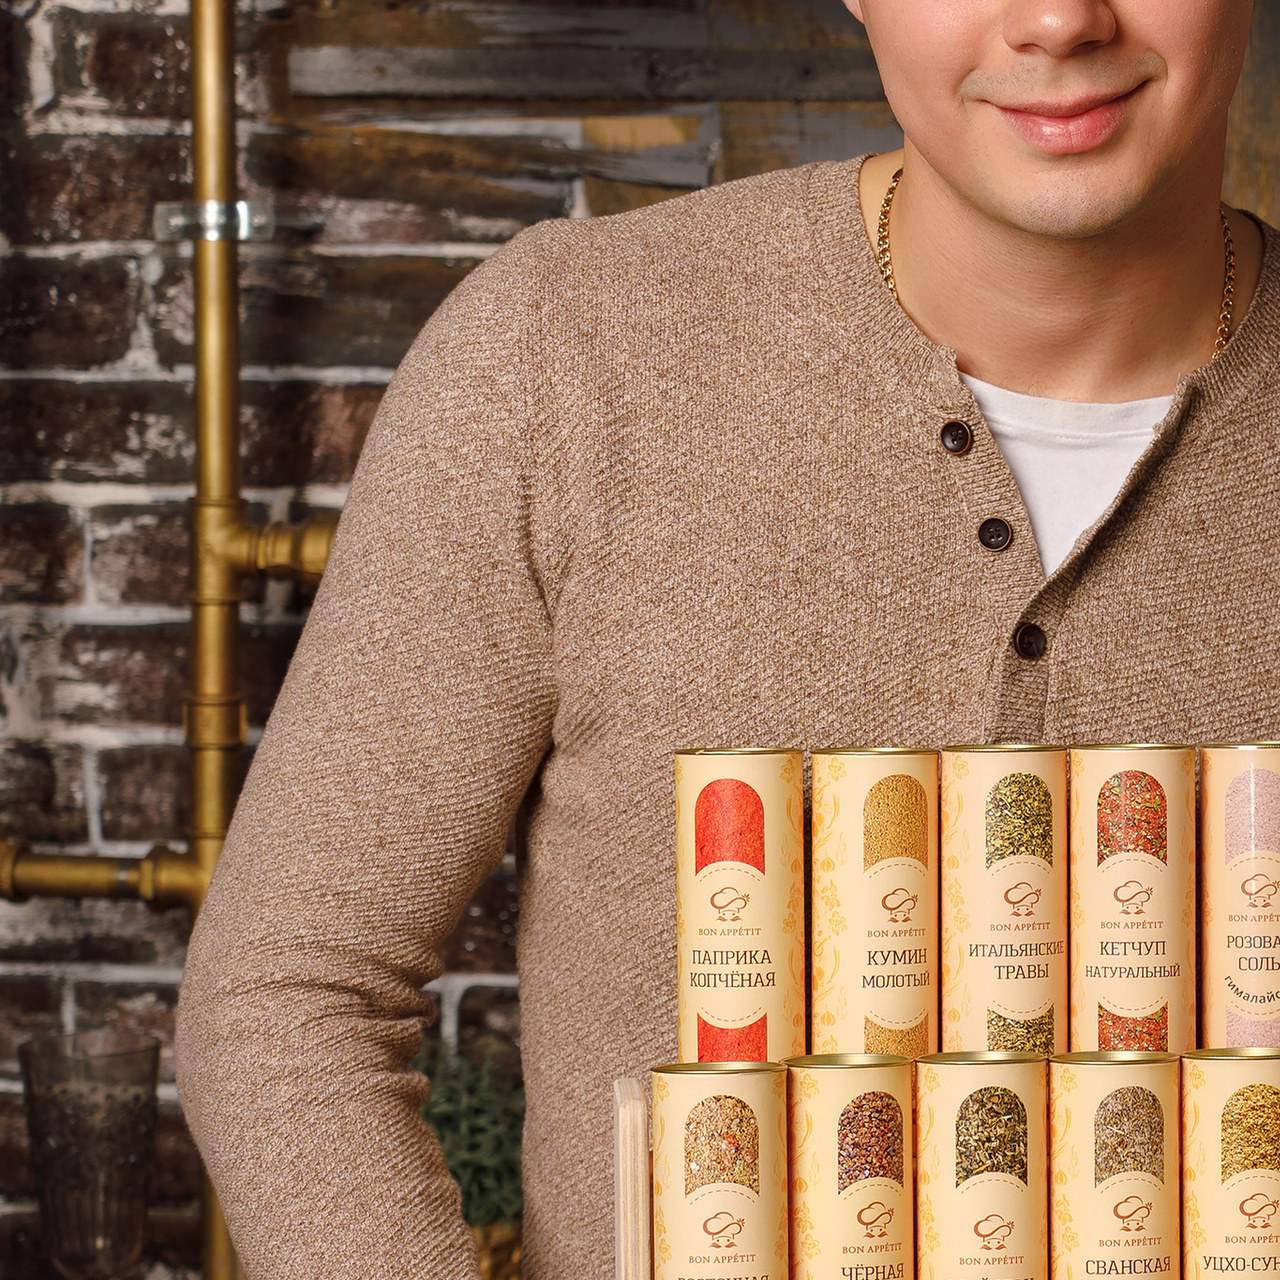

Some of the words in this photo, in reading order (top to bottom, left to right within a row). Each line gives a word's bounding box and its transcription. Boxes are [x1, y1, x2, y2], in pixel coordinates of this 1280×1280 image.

[1228, 914, 1248, 923] BON
[989, 923, 1012, 932] BON
[1100, 921, 1121, 930] BON
[698, 928, 718, 937] BON
[867, 929, 889, 938] BON
[969, 941, 1065, 958] ИТАЛЬЯНСКИЕ
[1099, 940, 1166, 956] КЕТЧУП
[692, 949, 772, 965] ПАПРИКА
[867, 948, 927, 966] КУМИН
[1238, 956, 1280, 972] СОЛЬ
[993, 963, 1049, 980] ТРАВЫ
[1085, 963, 1181, 979] НАТУРАЛЬНЫЙ
[689, 971, 776, 988] КОПЧЁНАЯ
[862, 972, 930, 989] МОЛОТЫЙ
[1098, 1239, 1121, 1248] BON
[1224, 1235, 1247, 1244] BON
[842, 1245, 865, 1255] BON
[688, 1255, 711, 1264] BON
[959, 1257, 981, 1266] BON
[1085, 1256, 1171, 1276] СВАНСКАЯ
